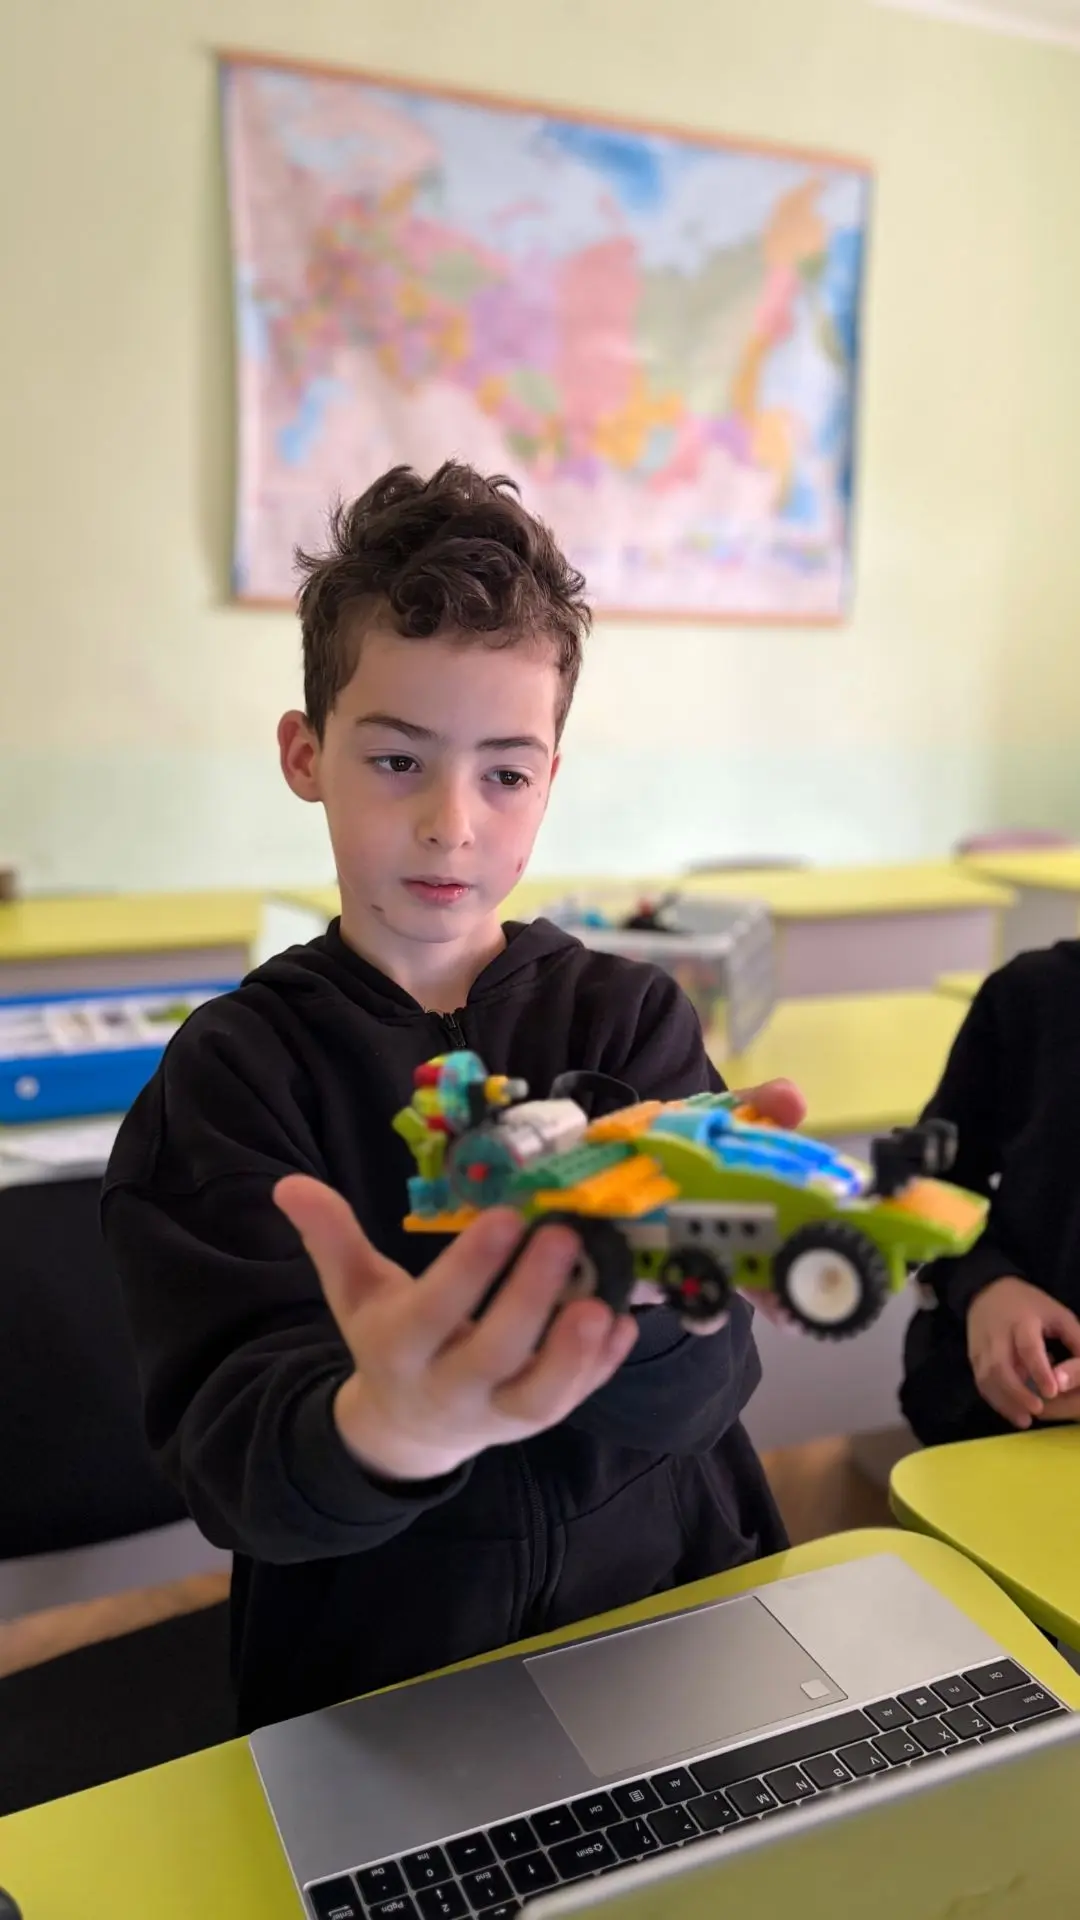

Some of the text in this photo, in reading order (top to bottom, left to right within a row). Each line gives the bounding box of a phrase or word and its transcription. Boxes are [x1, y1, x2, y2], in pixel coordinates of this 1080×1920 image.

[972, 1719, 984, 1728] Z
[938, 1731, 950, 1740] X
[903, 1743, 915, 1752] C
[869, 1756, 881, 1765] V
[833, 1768, 845, 1777] B
[795, 1780, 808, 1790] N
[756, 1793, 770, 1804] M
[589, 1804, 603, 1815] Ctrl
[417, 1852, 430, 1861] Ins
[576, 1847, 594, 1858] Shift
[371, 1867, 386, 1877] Del
[475, 1871, 492, 1882] End
[381, 1901, 404, 1912] PgDn
[441, 1903, 451, 1913] 2
